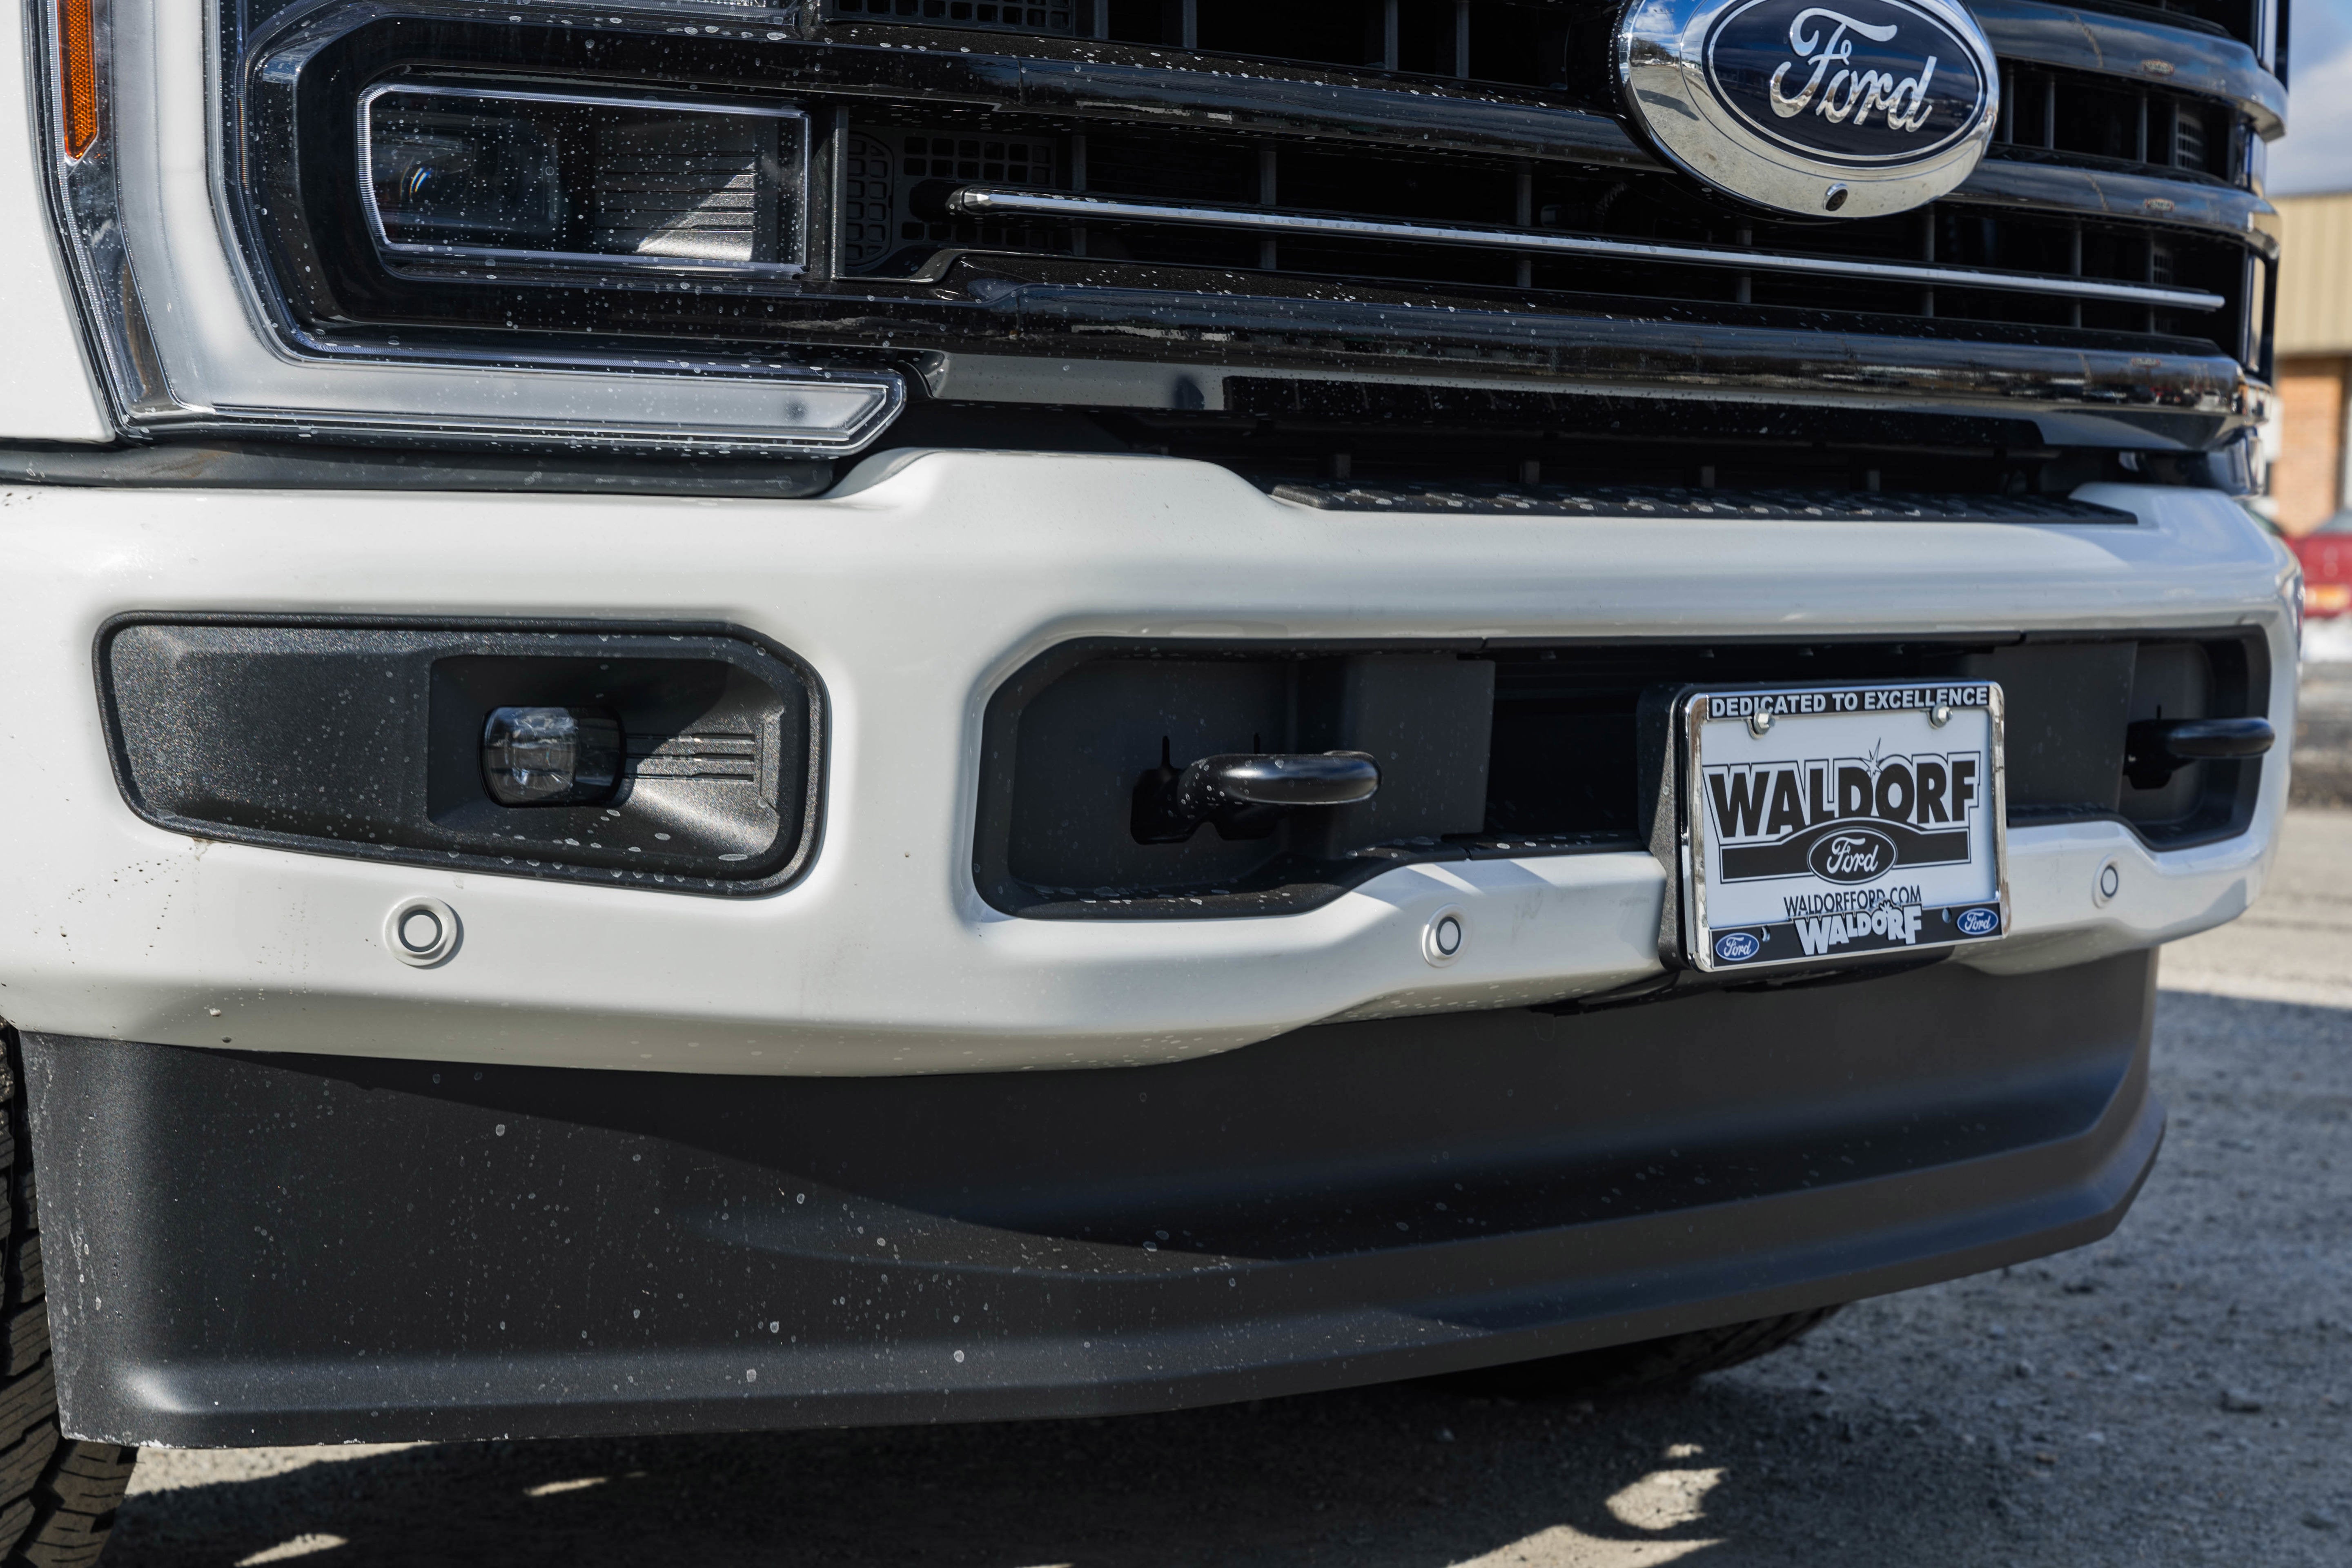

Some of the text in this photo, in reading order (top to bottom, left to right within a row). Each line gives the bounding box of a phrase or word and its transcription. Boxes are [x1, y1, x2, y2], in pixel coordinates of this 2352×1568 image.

[1769, 7, 1938, 133] Ford
[1712, 687, 1987, 717] DEDICATED TO EXCELLENCE
[1709, 760, 1975, 838] WALDORF
[1826, 837, 1879, 874] Ford
[1784, 885, 1922, 916] WALDORFFORDCOM
[1794, 903, 1922, 956] WALDORF
[1964, 912, 1991, 931] Ford
[1724, 937, 1751, 957] Ford
